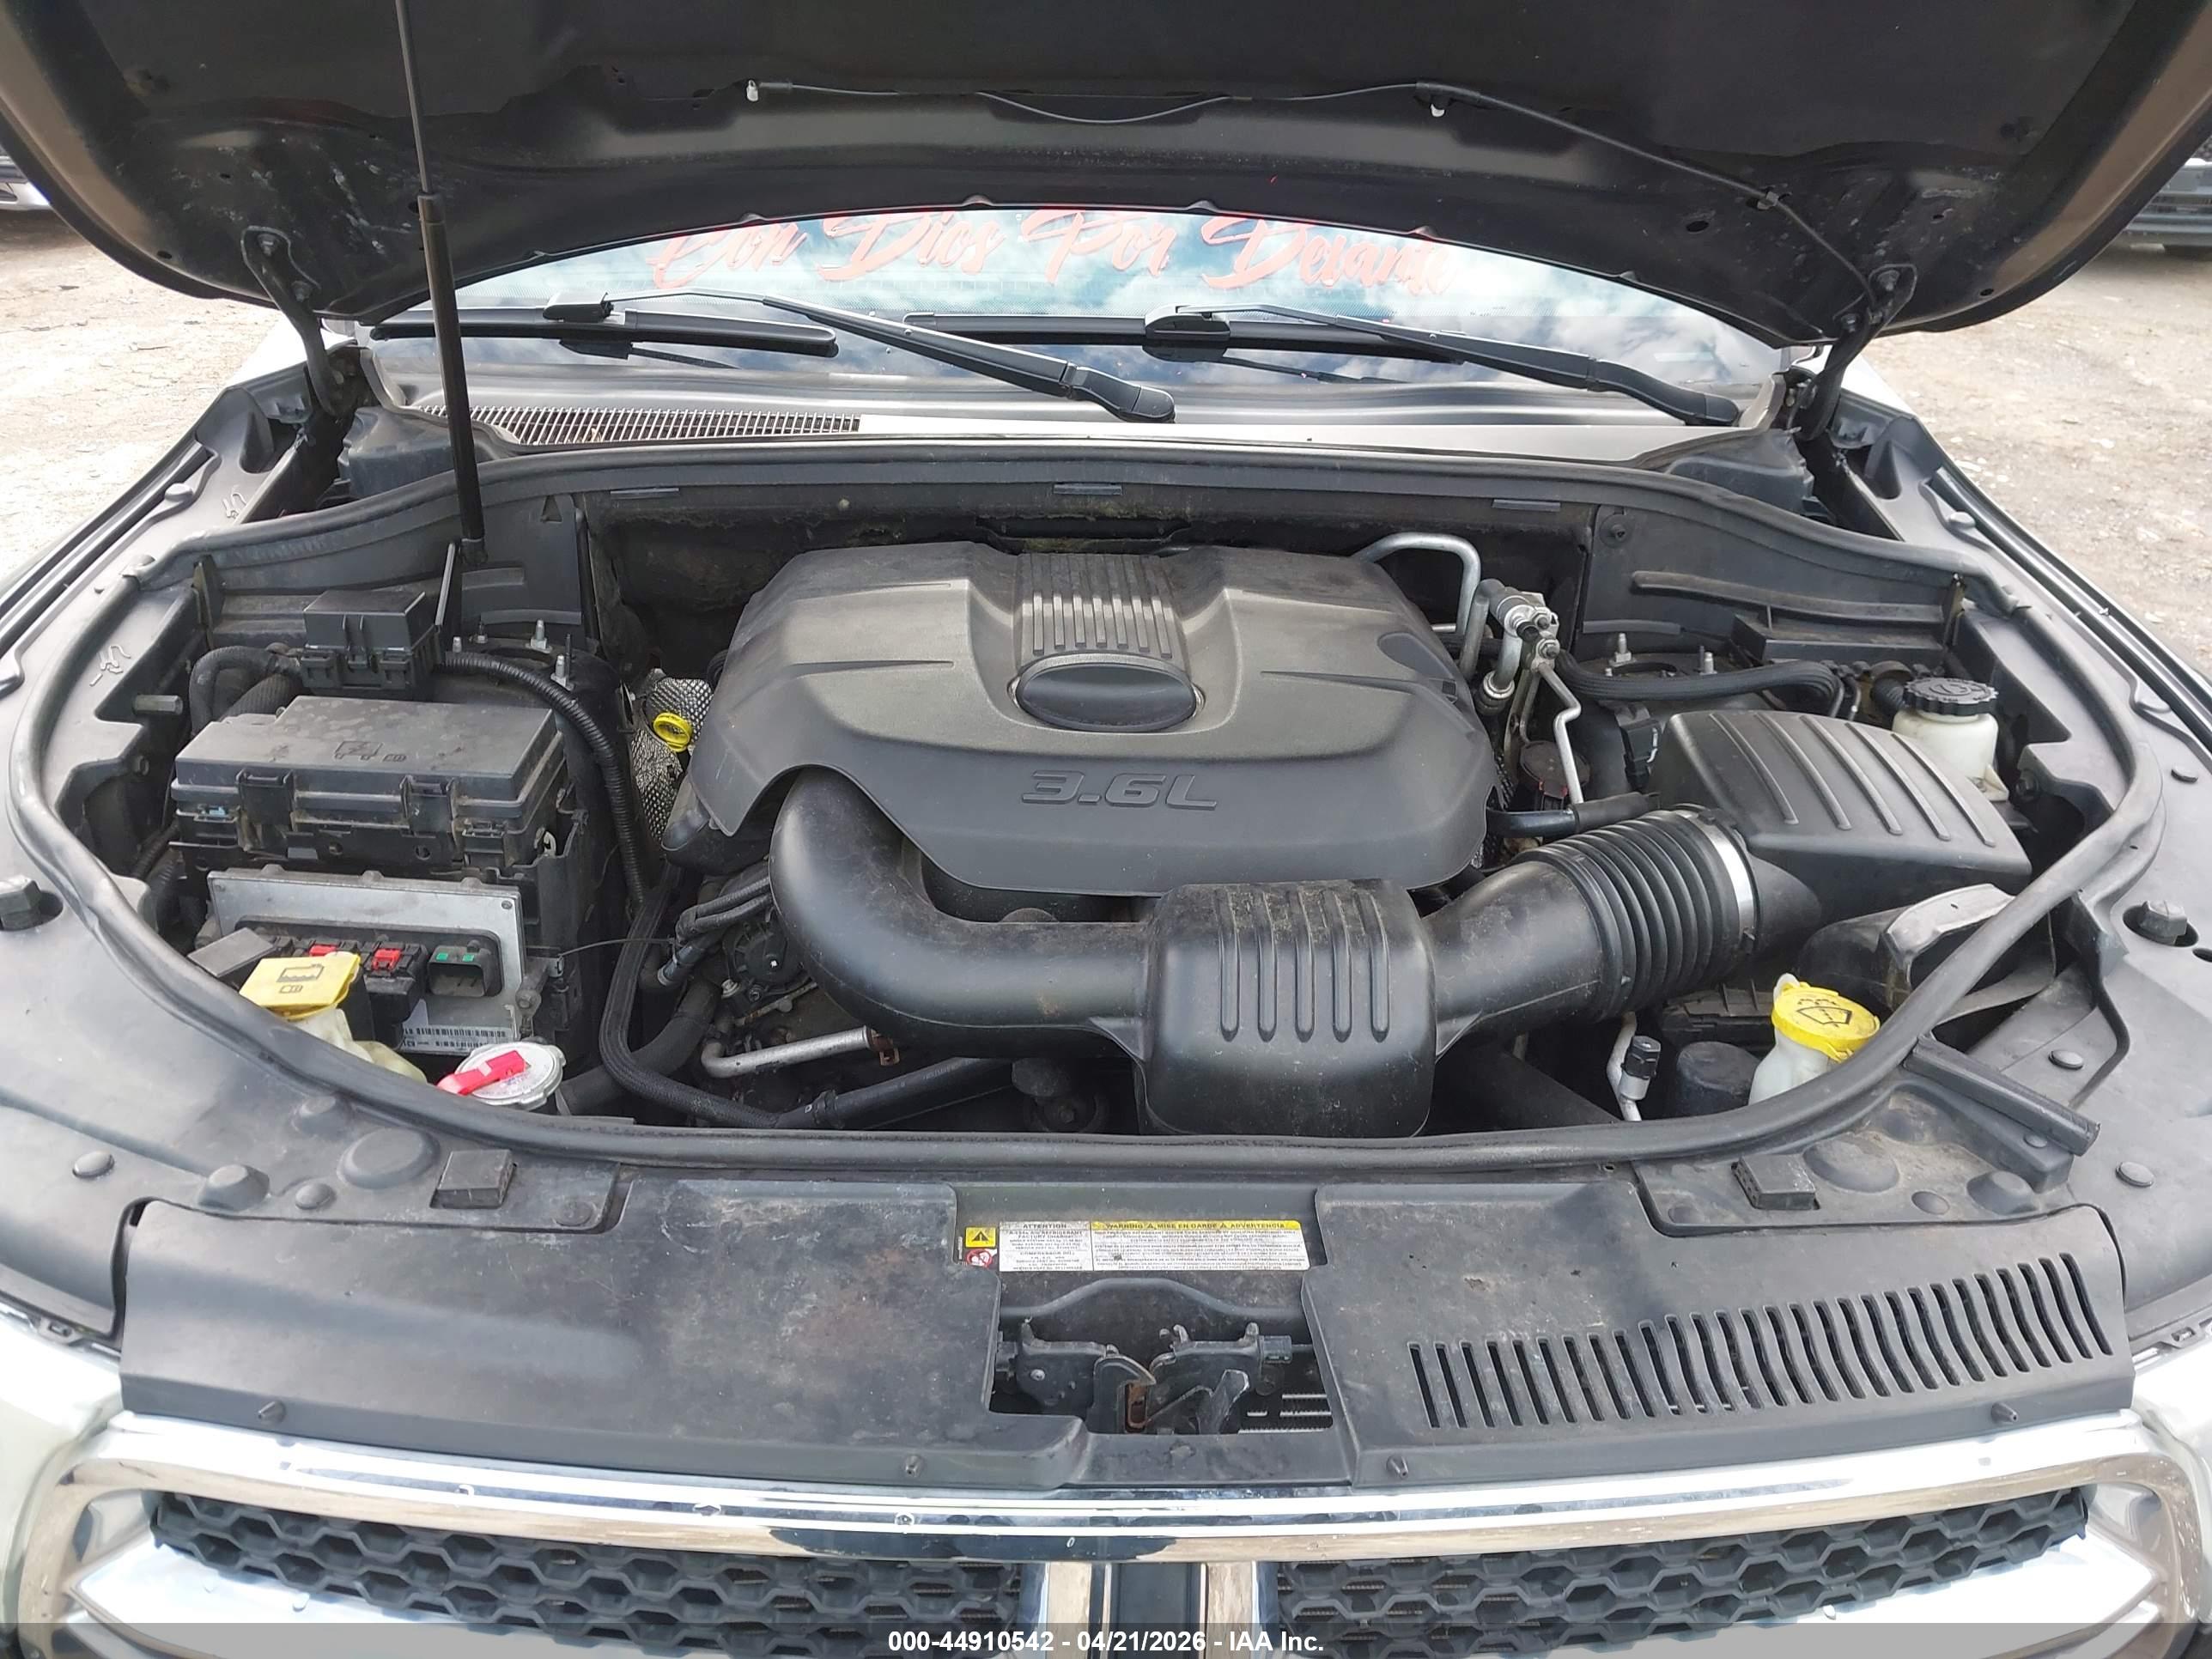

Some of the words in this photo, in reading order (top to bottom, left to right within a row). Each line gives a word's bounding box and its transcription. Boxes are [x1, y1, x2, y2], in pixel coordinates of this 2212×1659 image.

[817, 211, 1006, 282] Dios
[1021, 210, 1177, 284] Por
[1022, 769, 1218, 811] 3.6L
